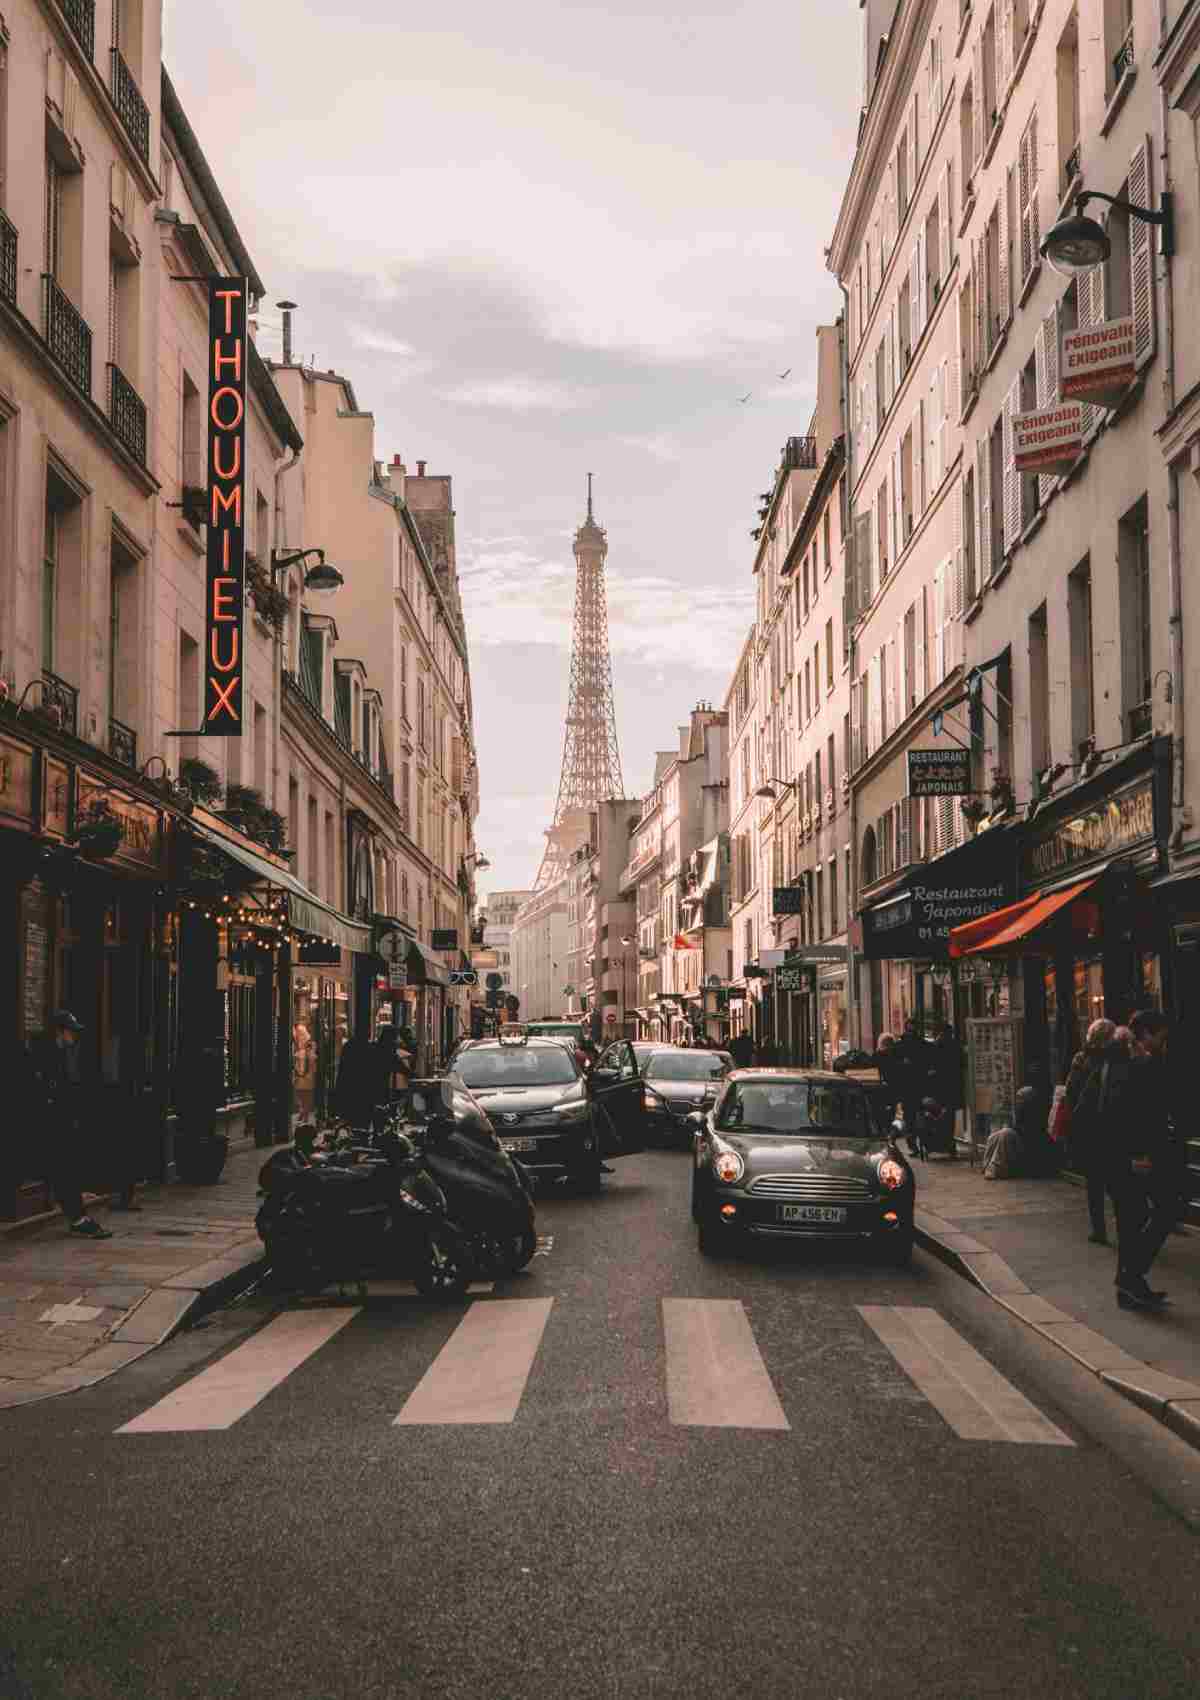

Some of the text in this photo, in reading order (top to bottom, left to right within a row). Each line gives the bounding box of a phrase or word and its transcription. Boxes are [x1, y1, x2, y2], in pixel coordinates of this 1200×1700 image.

[207, 290, 243, 720] THOUMIEUX
[911, 752, 967, 762] RESTAURANT
[915, 782, 963, 793] JAPONAIS
[913, 881, 1003, 900] Restaurant
[919, 928, 931, 938] 01
